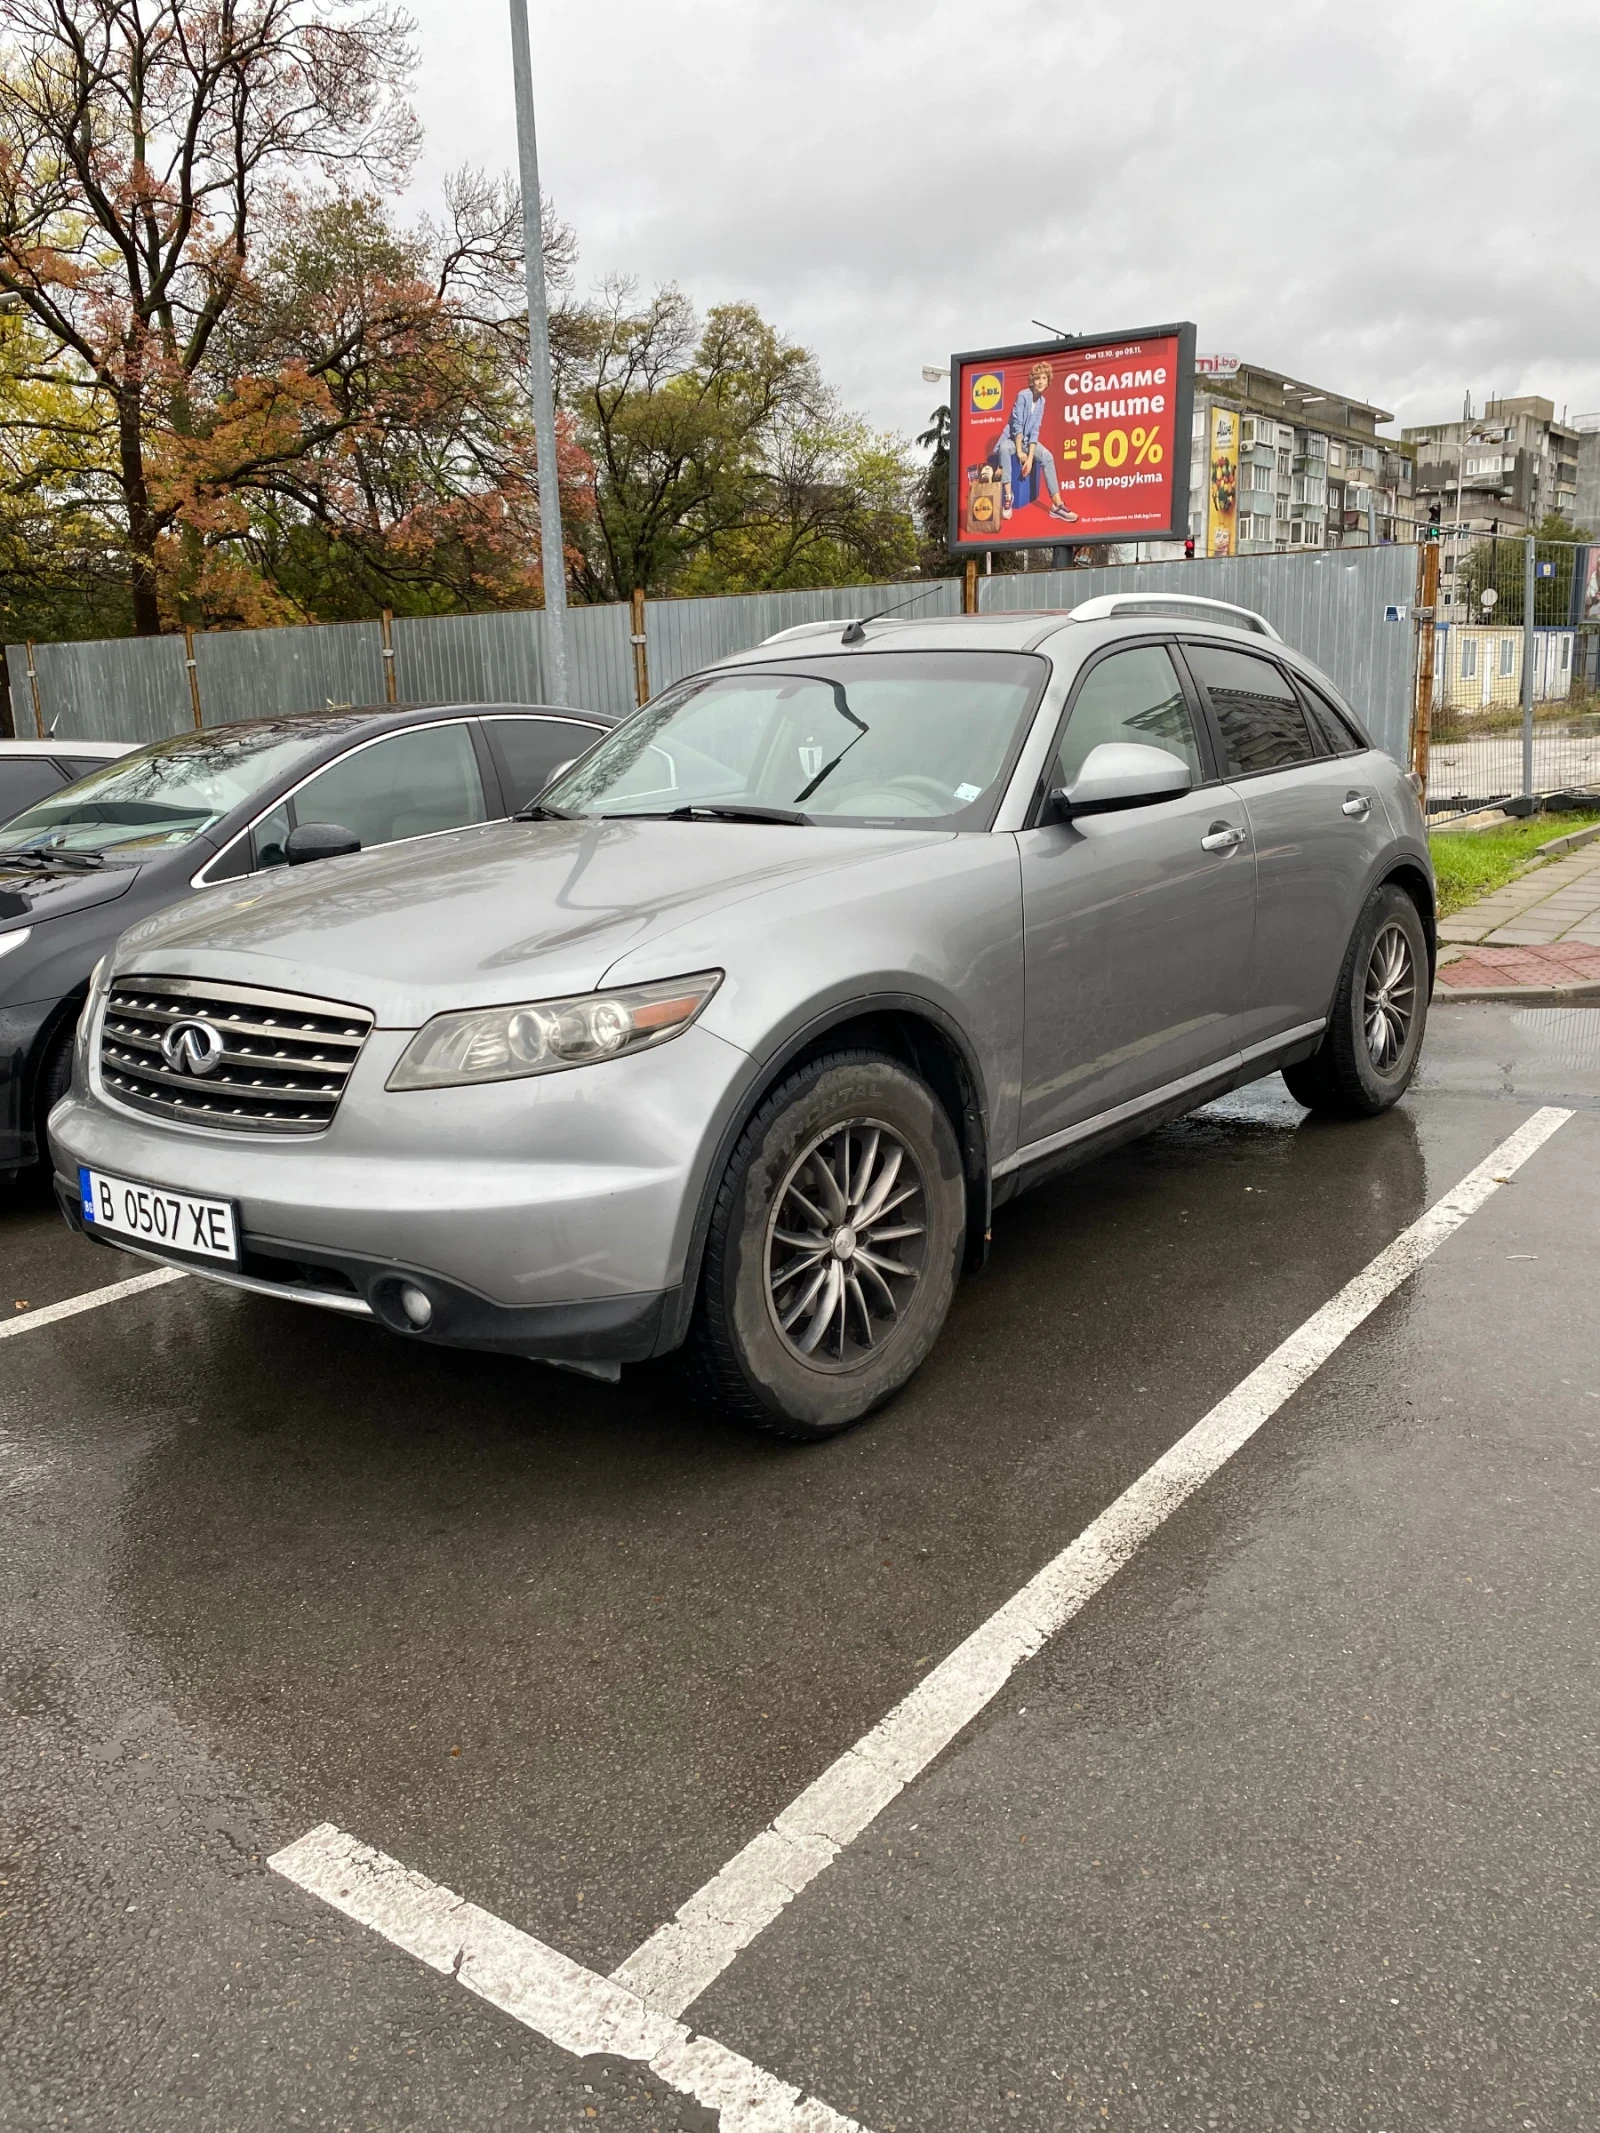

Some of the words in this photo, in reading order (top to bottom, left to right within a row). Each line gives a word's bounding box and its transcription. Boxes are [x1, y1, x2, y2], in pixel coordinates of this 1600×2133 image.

[1064, 367, 1167, 395] Сваляме
[1064, 394, 1165, 425] цените
[1063, 438, 1078, 450] до
[1061, 480, 1076, 490] на
[1078, 476, 1094, 488] 50
[1096, 471, 1163, 490] продукта
[84, 1200, 94, 1214] BG
[99, 1180, 114, 1222] B
[125, 1189, 181, 1240] 0507
[188, 1203, 230, 1252] XE
